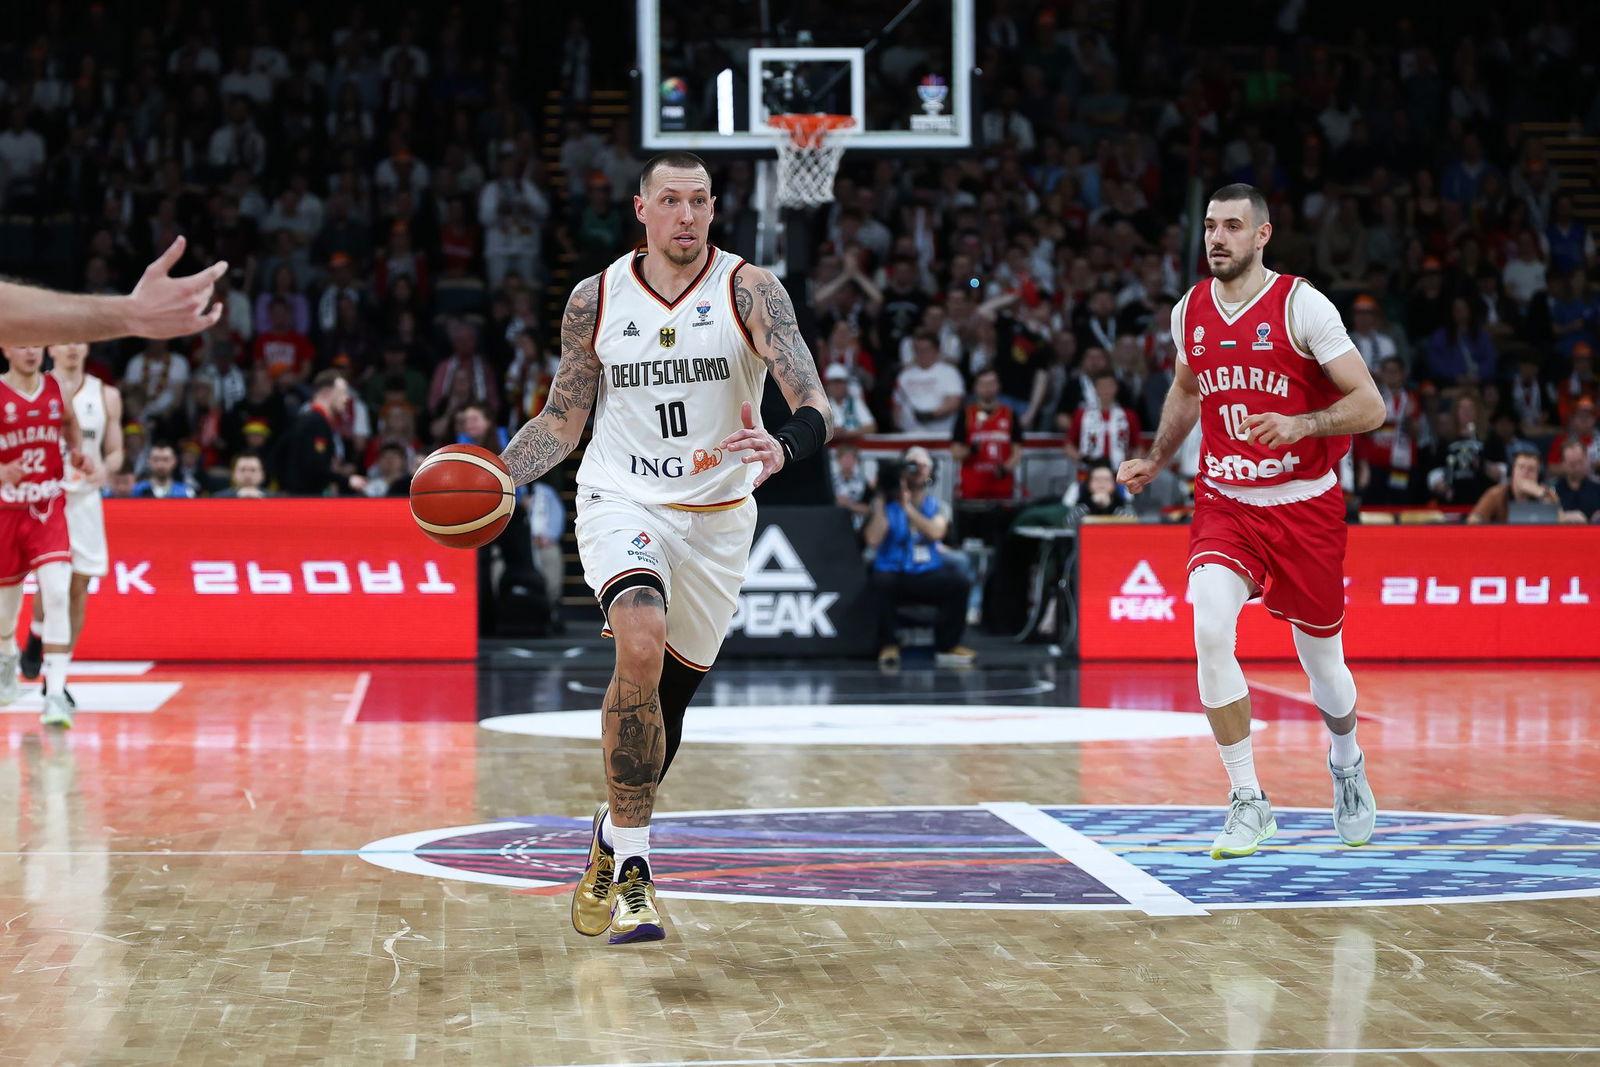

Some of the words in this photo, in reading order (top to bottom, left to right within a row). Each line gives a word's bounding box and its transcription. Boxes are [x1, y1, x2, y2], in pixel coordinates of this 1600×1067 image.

[623, 329, 640, 337] PEAK
[611, 357, 731, 388] DEUTSCHLAND
[1198, 365, 1289, 400] ULGARIA
[655, 401, 688, 439] 10
[1218, 403, 1251, 441] 10
[21, 447, 46, 474] 22
[629, 454, 684, 478] ING
[1204, 451, 1300, 481] efbet
[1109, 595, 1176, 621] PEAK
